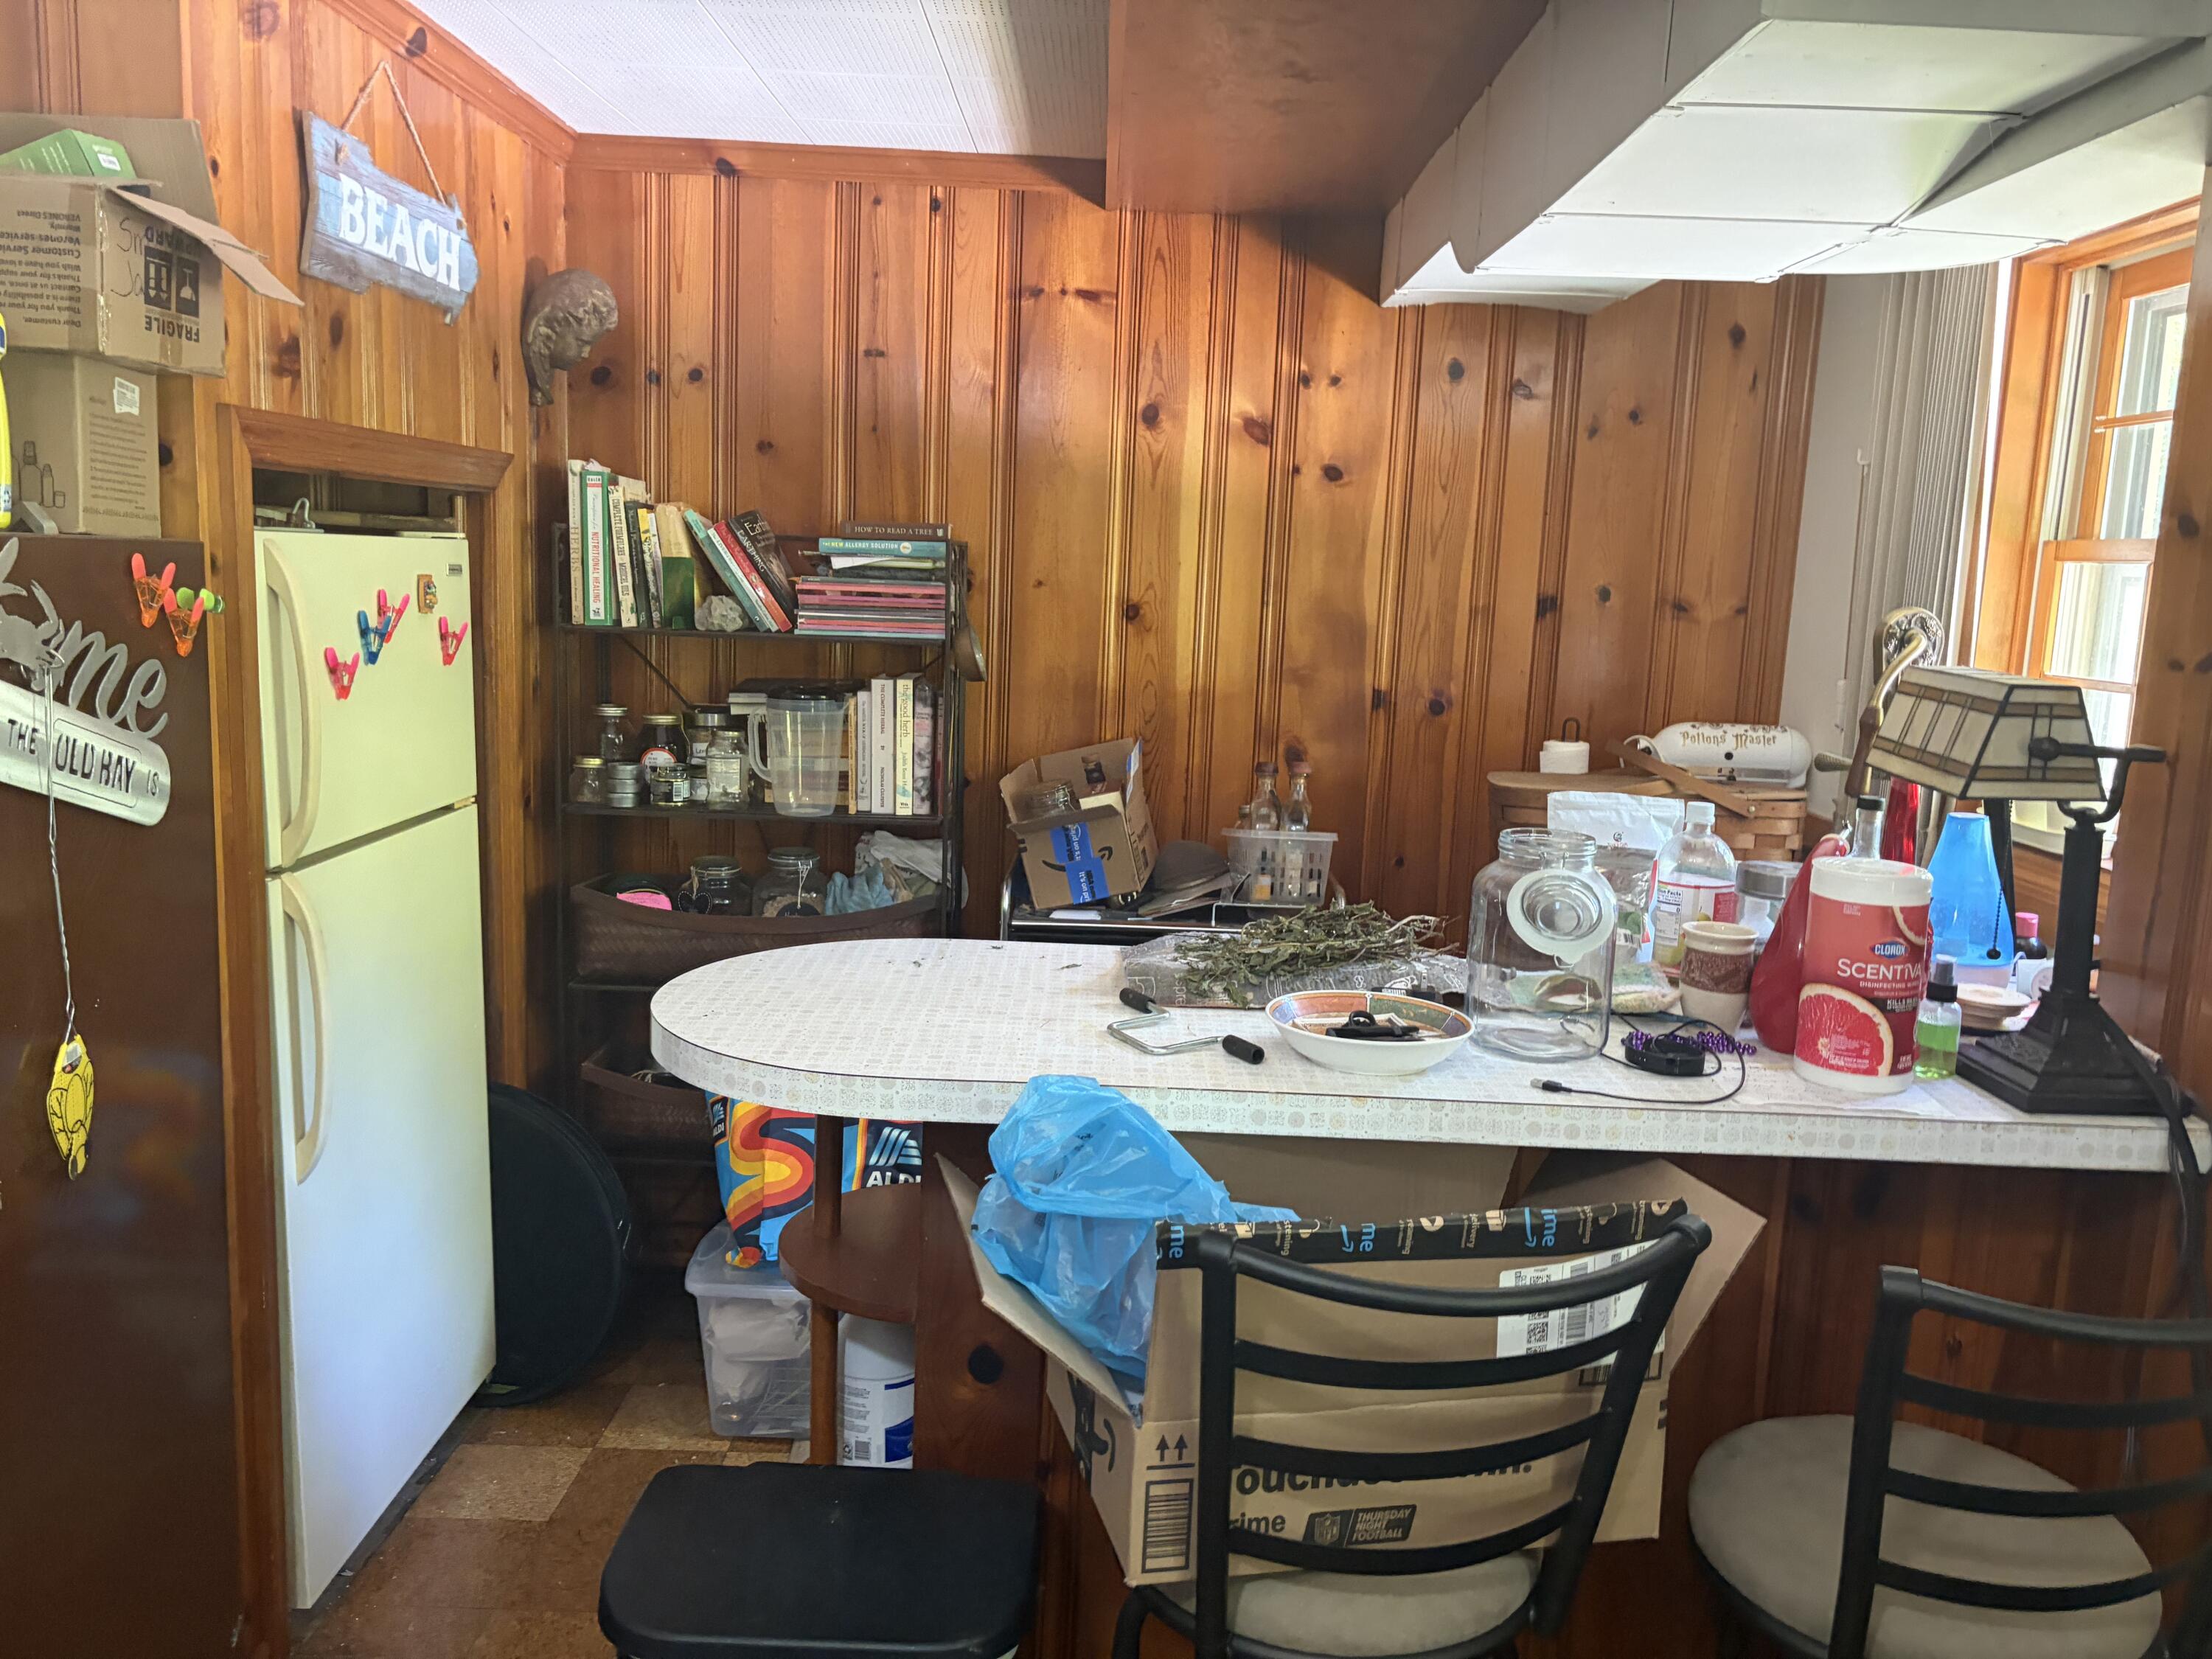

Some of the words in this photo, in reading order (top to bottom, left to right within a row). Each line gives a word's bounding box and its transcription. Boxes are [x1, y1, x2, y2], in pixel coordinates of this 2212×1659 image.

[338, 172, 462, 292] BEACH
[32, 247, 80, 259] Customer
[145, 315, 200, 343] FRAGILE
[612, 498, 622, 526] COMPLETE
[855, 526, 873, 534] HOW
[887, 526, 906, 535] READ
[915, 528, 933, 536] TREE
[571, 526, 580, 572] HERBS
[591, 532, 599, 574] NUTRITIONAL
[737, 529, 768, 572] EARTHING
[901, 698, 910, 717] good
[902, 720, 910, 737] herb
[1680, 730, 1726, 747] Potions
[1732, 731, 1777, 751] Master
[7, 717, 39, 756] THE
[55, 731, 95, 782] OLD
[99, 747, 136, 794] BAY
[147, 768, 160, 797] IS
[1874, 944, 1906, 956] CLOROX
[1860, 981, 1906, 990] DISINFECTING
[1357, 1507, 1412, 1524] THURSDAY
[1352, 1528, 1403, 1542] FOOTBALL
[1355, 1520, 1387, 1531] NIGHT
